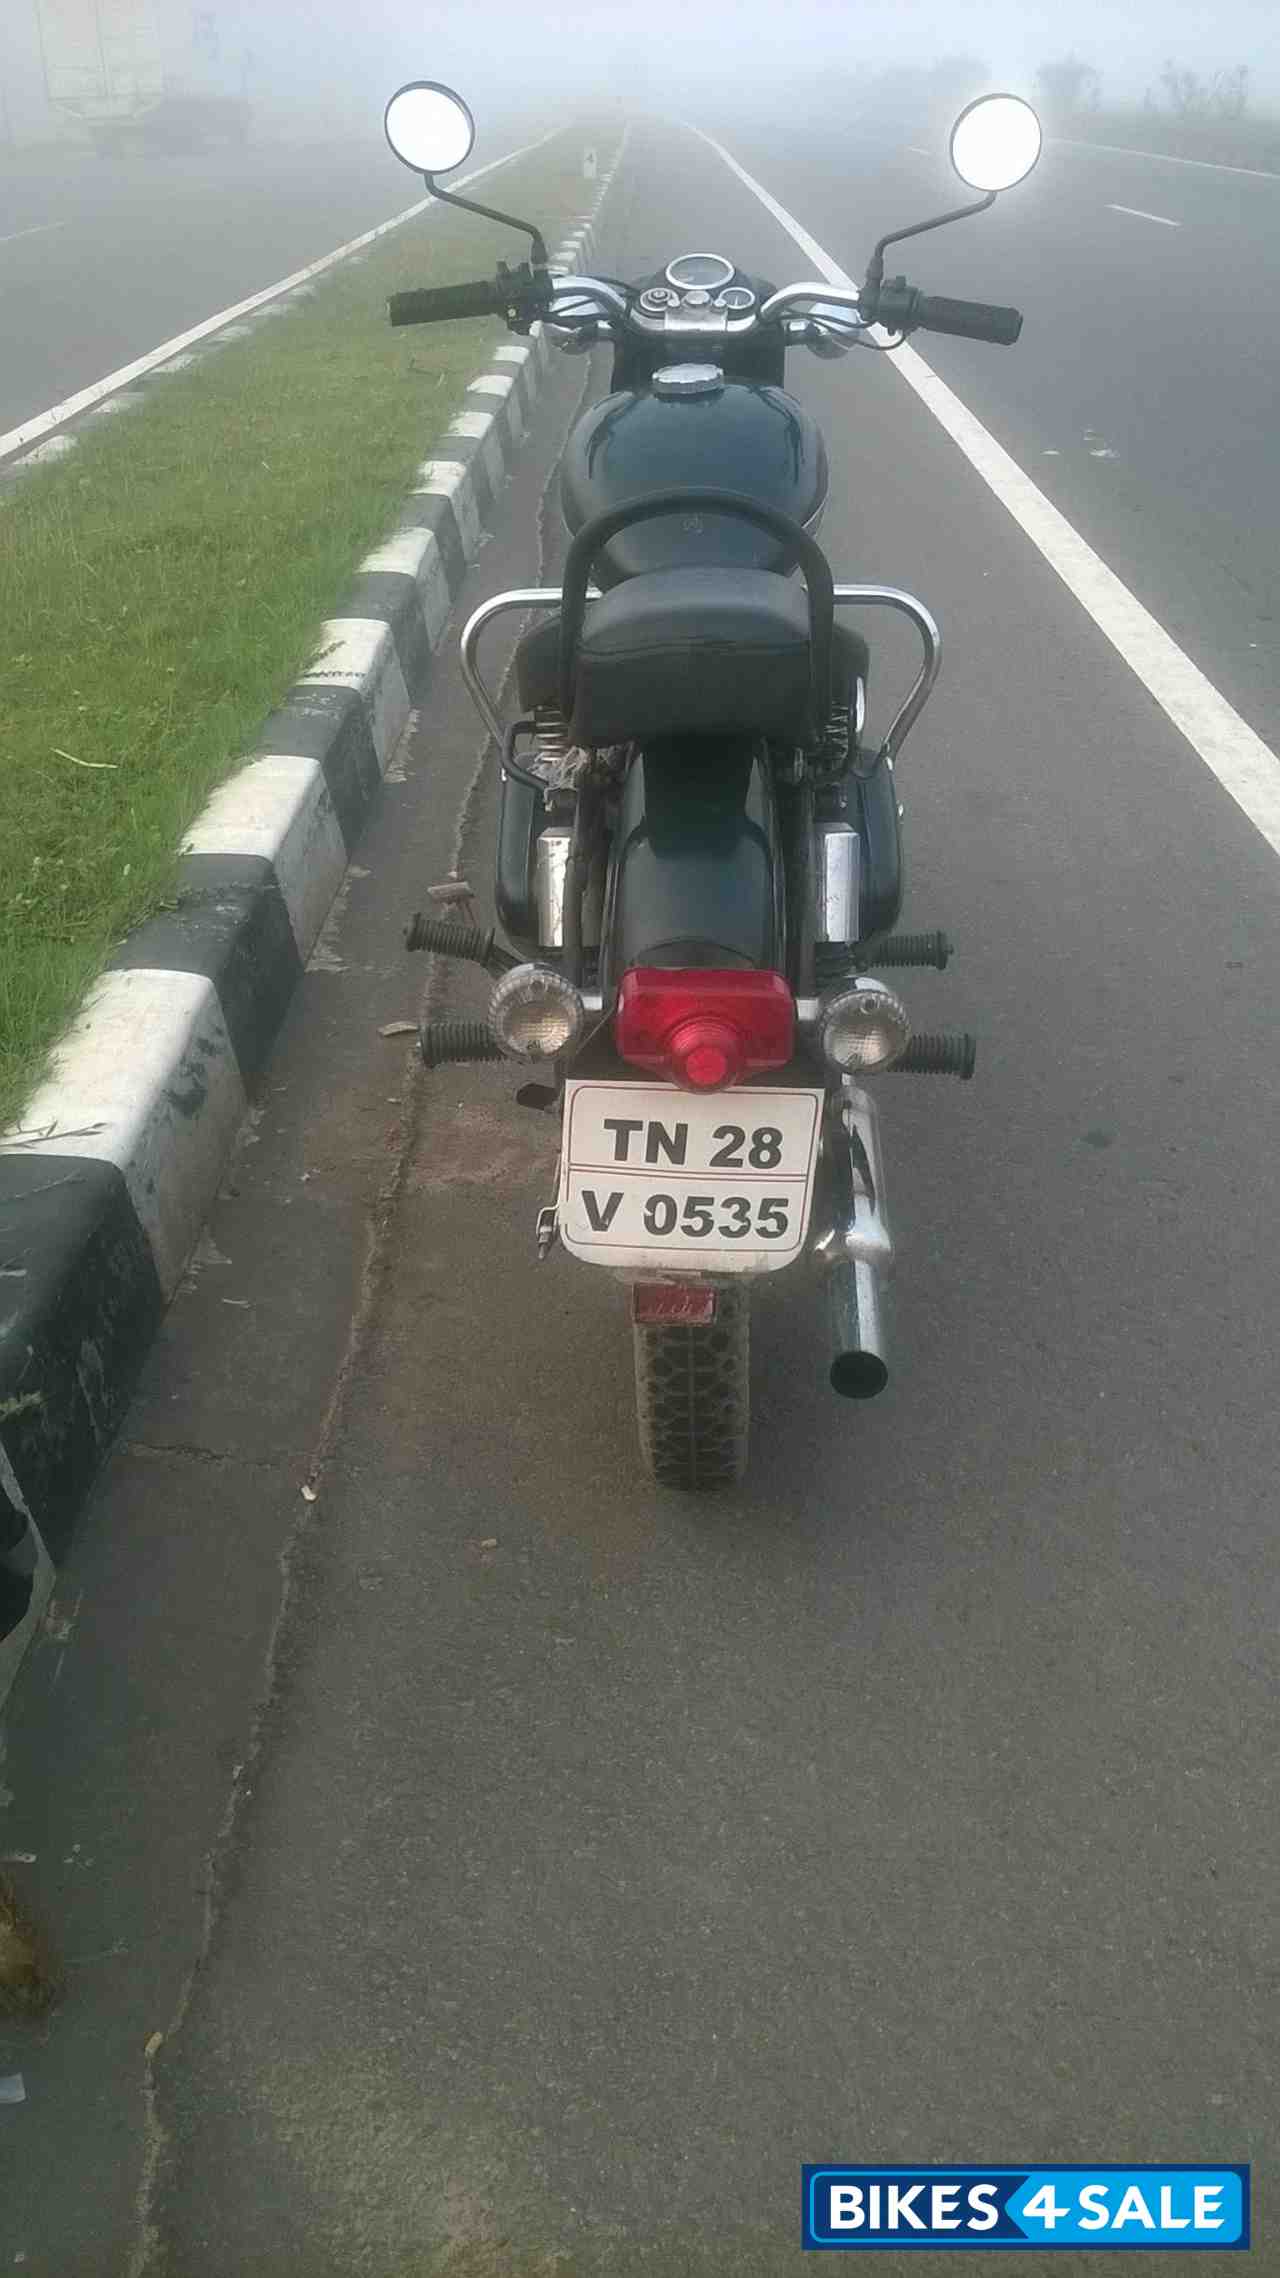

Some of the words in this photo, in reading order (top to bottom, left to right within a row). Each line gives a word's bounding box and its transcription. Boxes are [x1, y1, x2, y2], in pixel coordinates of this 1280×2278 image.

[604, 1118, 689, 1165] TN
[709, 1125, 783, 1169] 28
[581, 1190, 624, 1232] V
[643, 1194, 789, 1239] 0535
